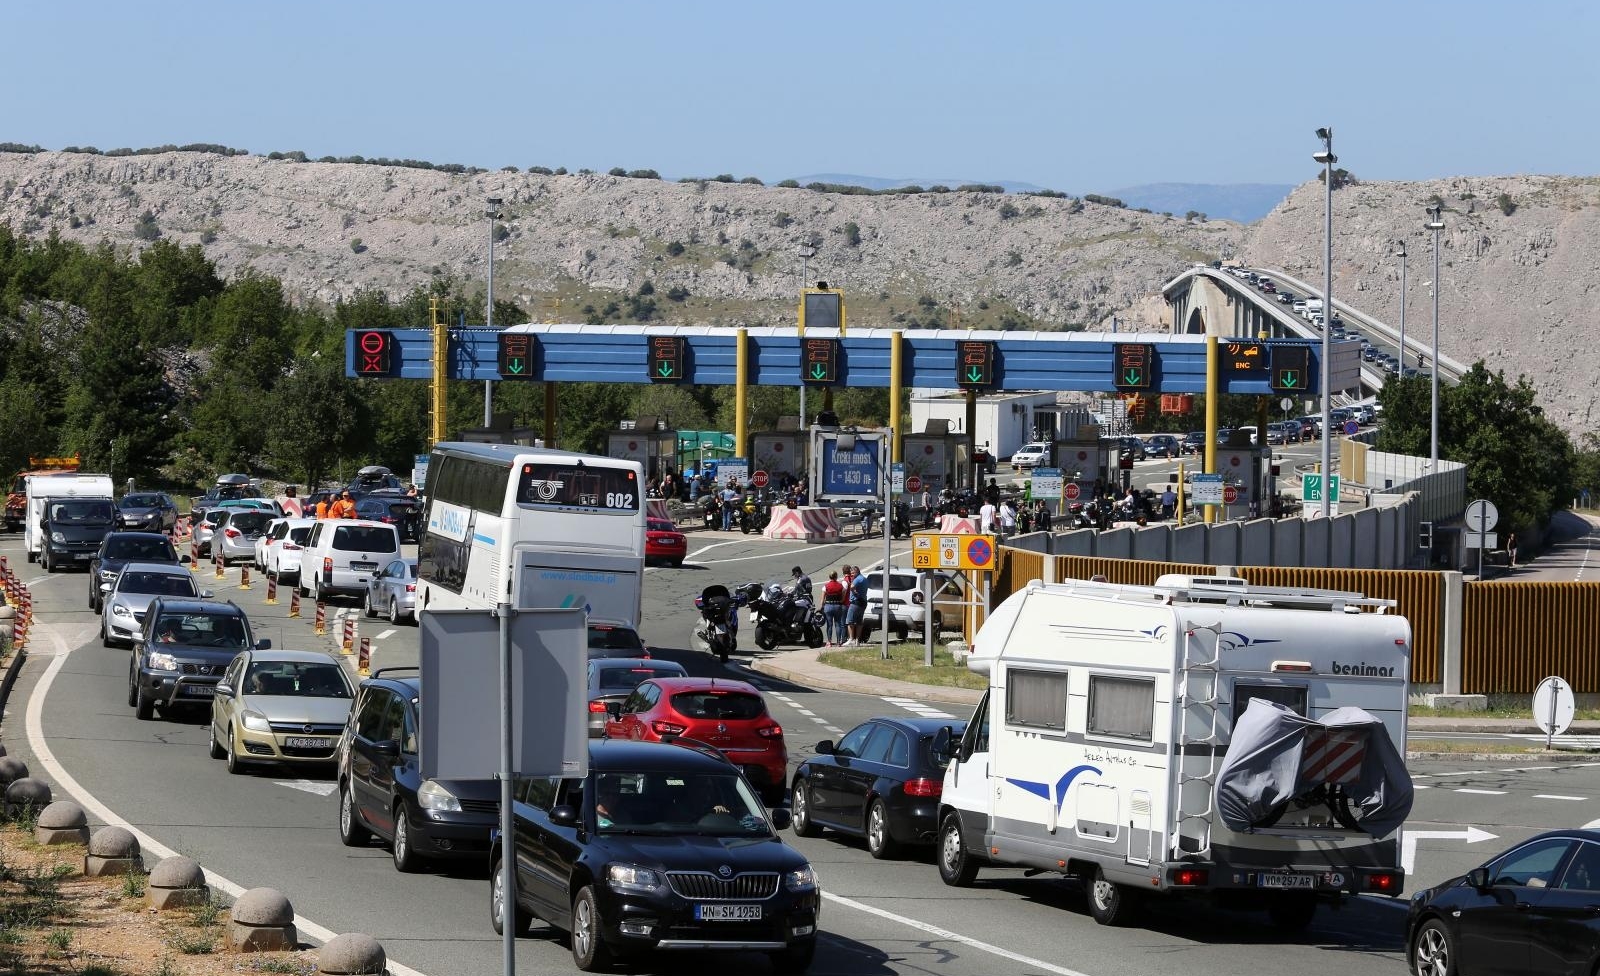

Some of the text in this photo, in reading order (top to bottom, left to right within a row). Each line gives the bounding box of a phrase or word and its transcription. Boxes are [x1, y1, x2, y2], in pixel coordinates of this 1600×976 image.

[852, 452, 871, 465] most
[831, 470, 836, 484] L
[844, 470, 861, 485] 1430
[907, 481, 920, 489] STOP
[1065, 488, 1079, 496] STOP
[605, 492, 633, 509] 602
[917, 555, 929, 564] 29
[541, 570, 616, 585] www.sindbad.pl
[1331, 660, 1395, 677] benimar
[1282, 876, 1298, 887] 297
[1300, 877, 1311, 887] AR
[702, 906, 760, 918] WN SW 1958
